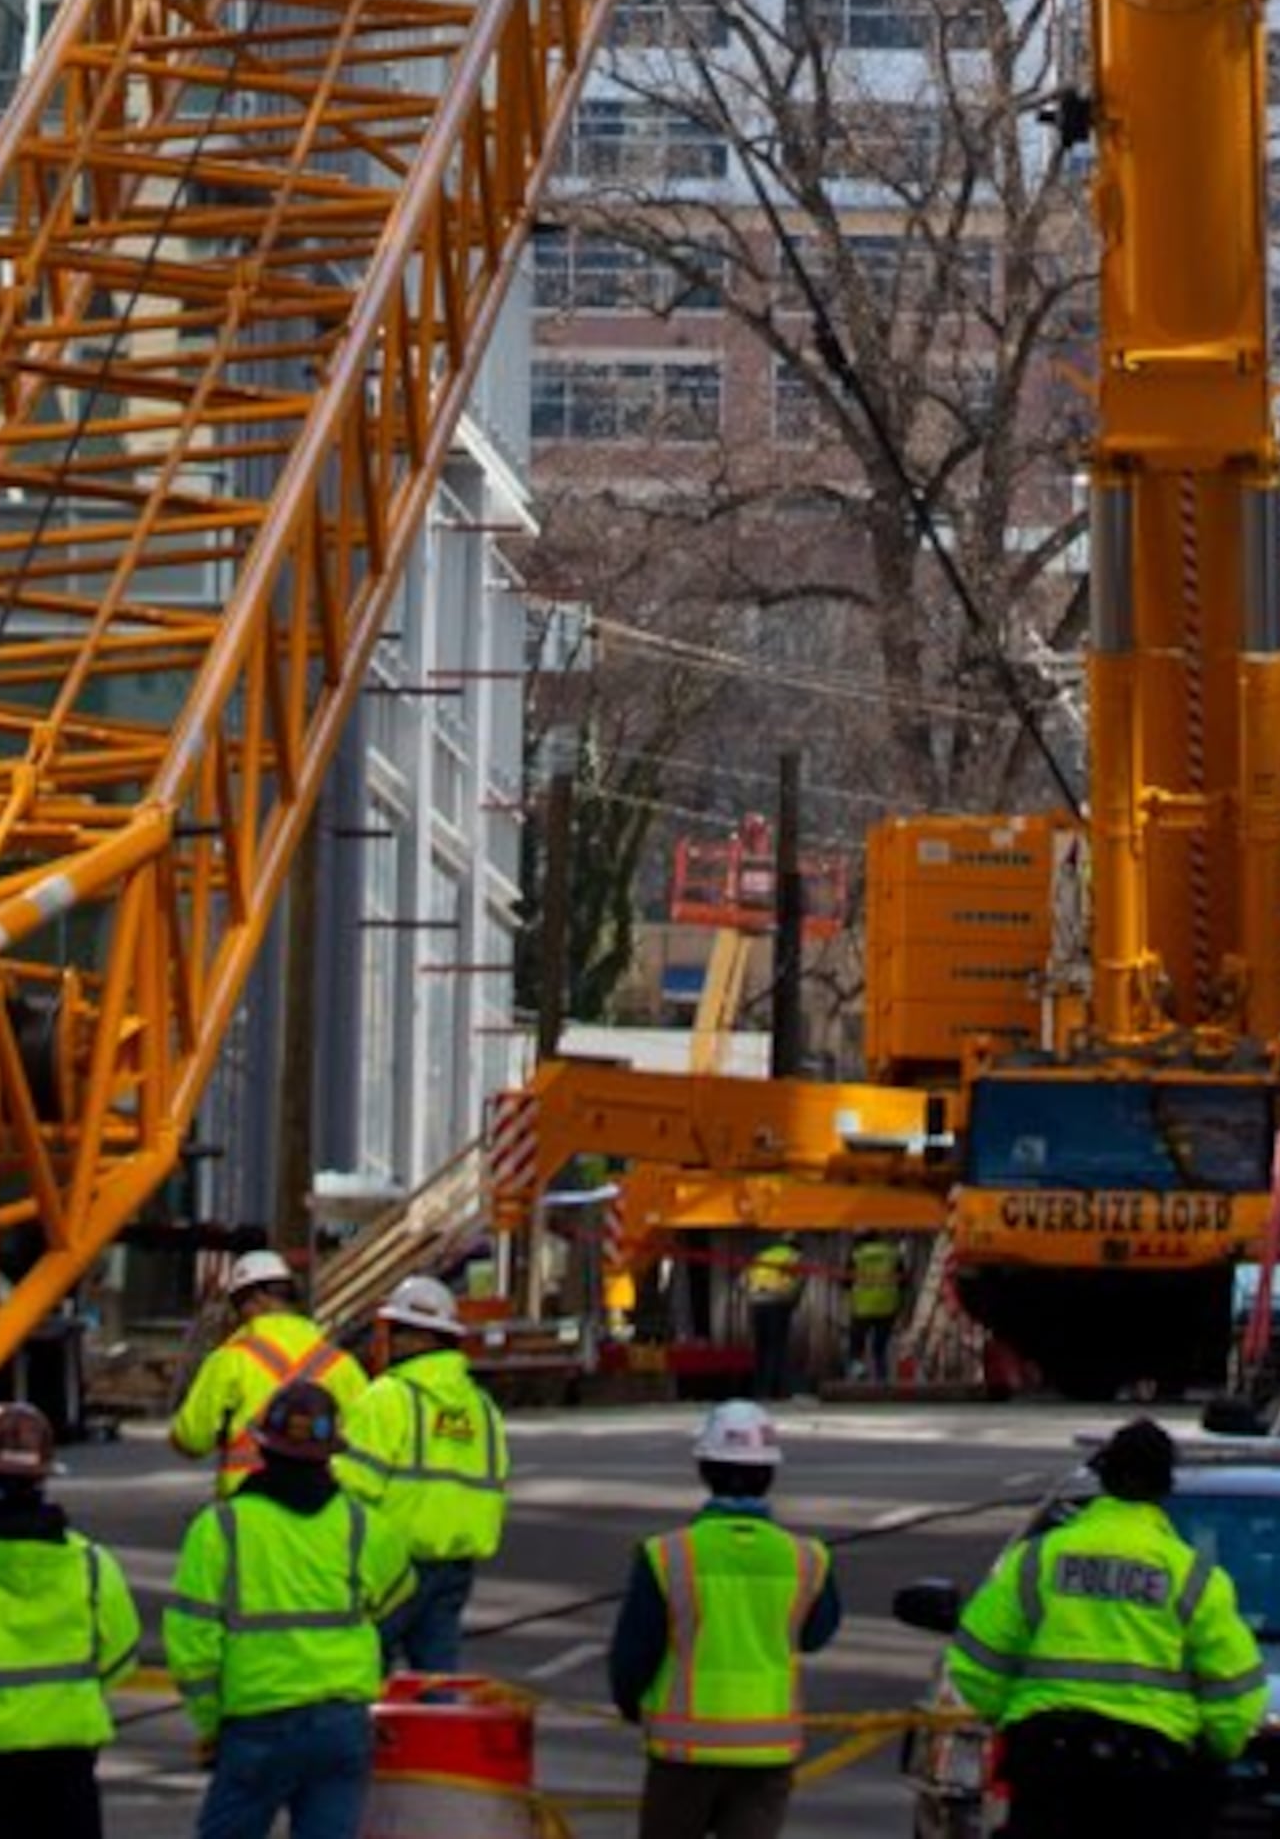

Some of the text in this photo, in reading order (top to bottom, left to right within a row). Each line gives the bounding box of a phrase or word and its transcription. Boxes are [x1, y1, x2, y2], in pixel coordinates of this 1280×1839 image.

[1002, 1193, 1232, 1233] OVERSIZE LOAD
[1058, 1556, 1168, 1604] POLICE
